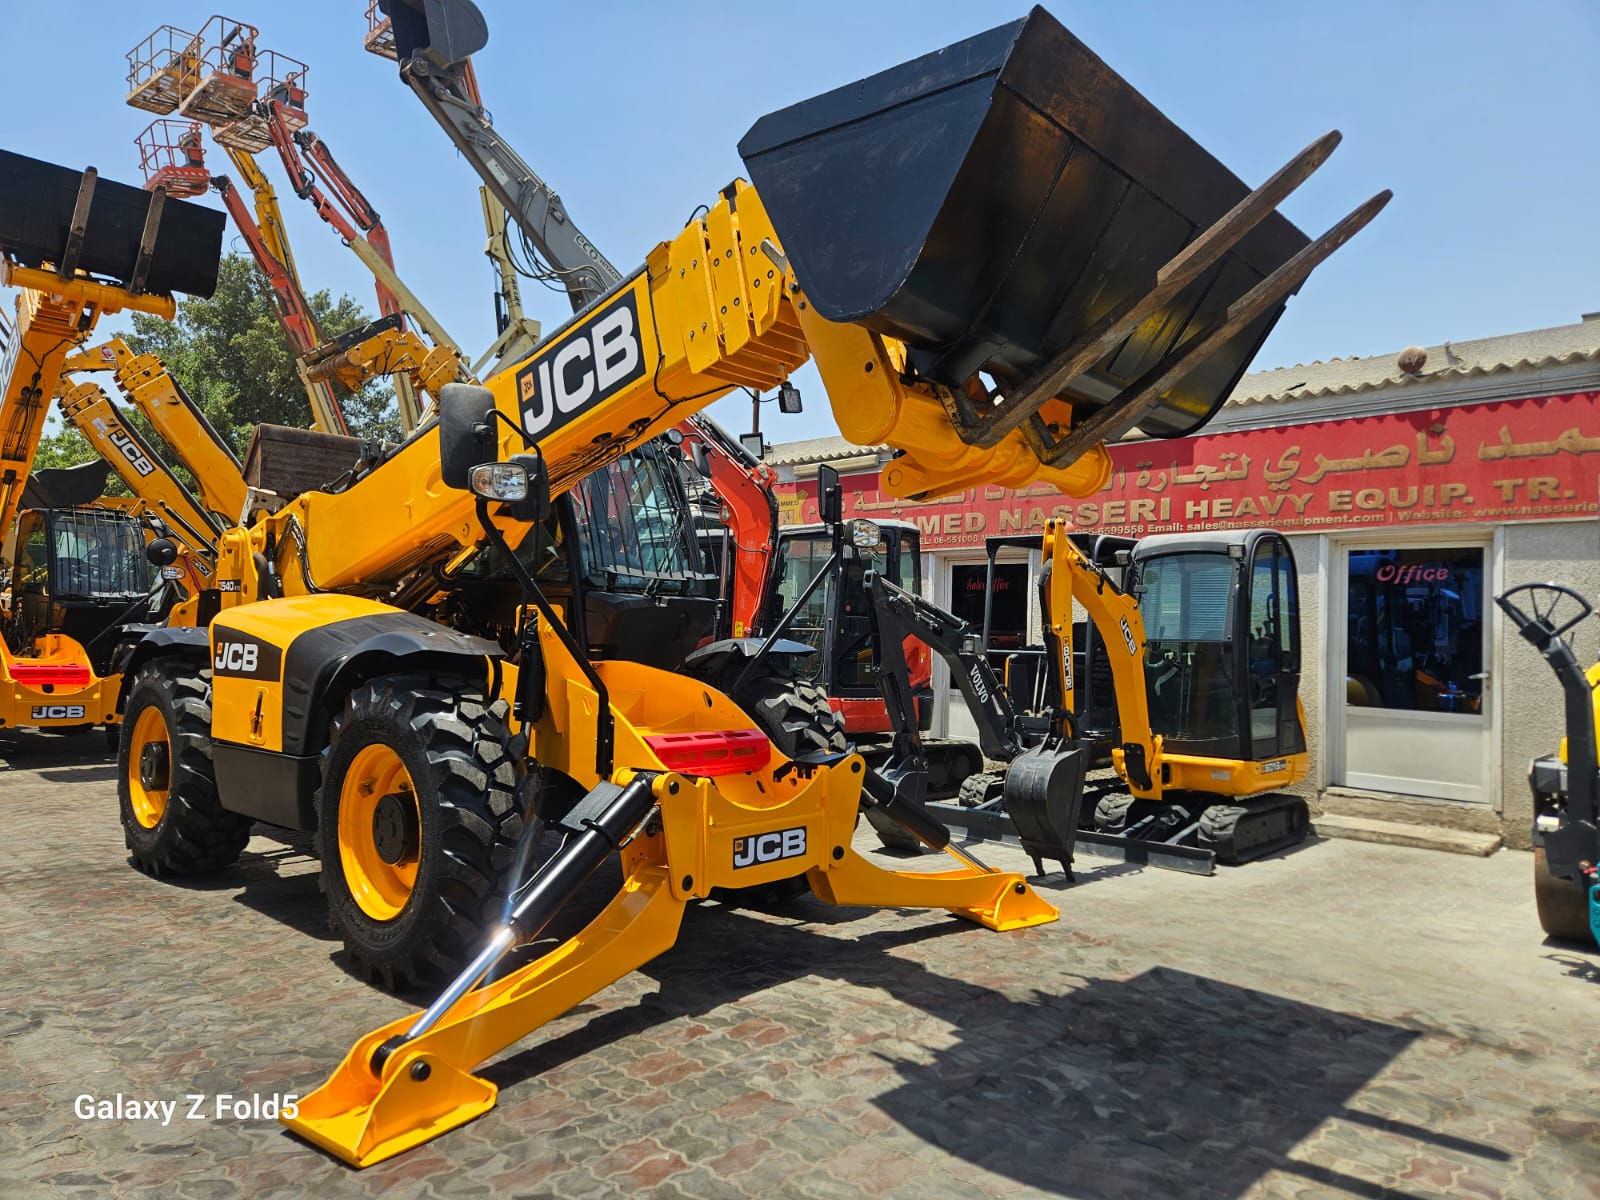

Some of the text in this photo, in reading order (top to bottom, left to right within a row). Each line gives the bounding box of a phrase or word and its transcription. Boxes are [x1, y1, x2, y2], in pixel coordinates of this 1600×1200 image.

[523, 305, 639, 435] JCB
[110, 430, 154, 476] JCB
[1263, 423, 1456, 491] ناصري
[1001, 497, 1171, 531] NASSERI
[1186, 492, 1314, 520] HEAVY
[1329, 482, 1474, 512] EQUIP.
[1493, 476, 1577, 502] TR.
[1148, 522, 1183, 533] Email:
[1187, 514, 1385, 531] sales@nasseriequipment.com
[1399, 508, 1468, 521] Website:
[1376, 564, 1449, 584] Office
[1119, 617, 1137, 655] JCB
[215, 642, 259, 672] JCB
[969, 664, 989, 704] VOLVO
[32, 706, 84, 719] JCB
[734, 828, 806, 867] JCB
